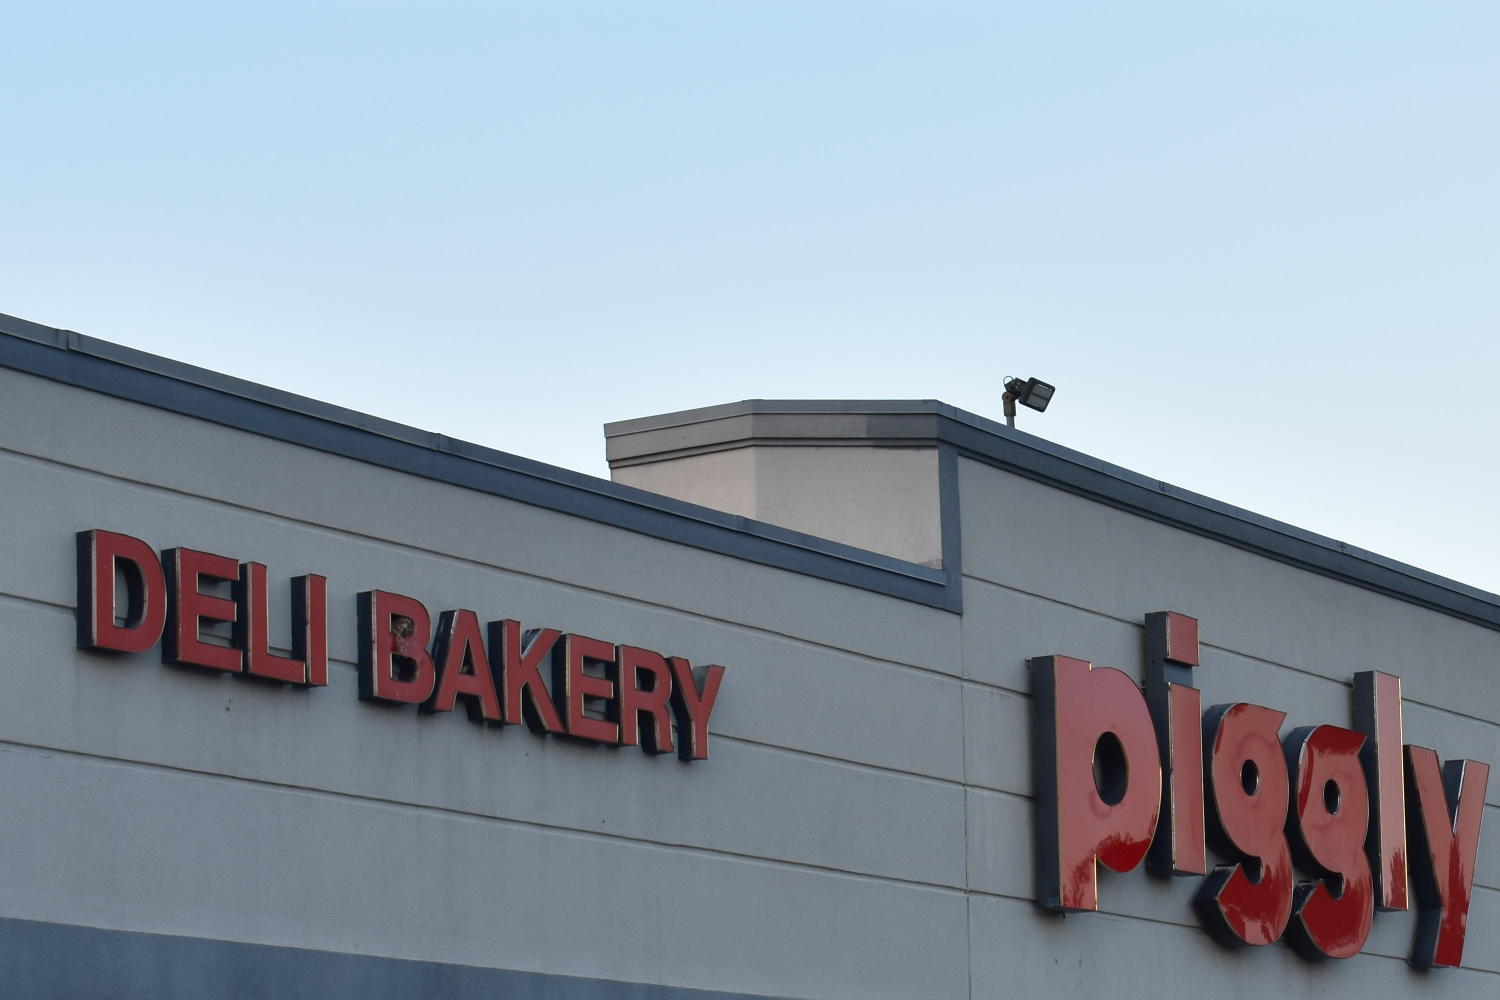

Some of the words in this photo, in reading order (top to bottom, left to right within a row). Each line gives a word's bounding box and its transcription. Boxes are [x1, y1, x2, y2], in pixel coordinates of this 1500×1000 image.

[77, 528, 328, 687] DELI
[358, 589, 725, 760] BAKERY
[1031, 610, 1490, 968] piggly
